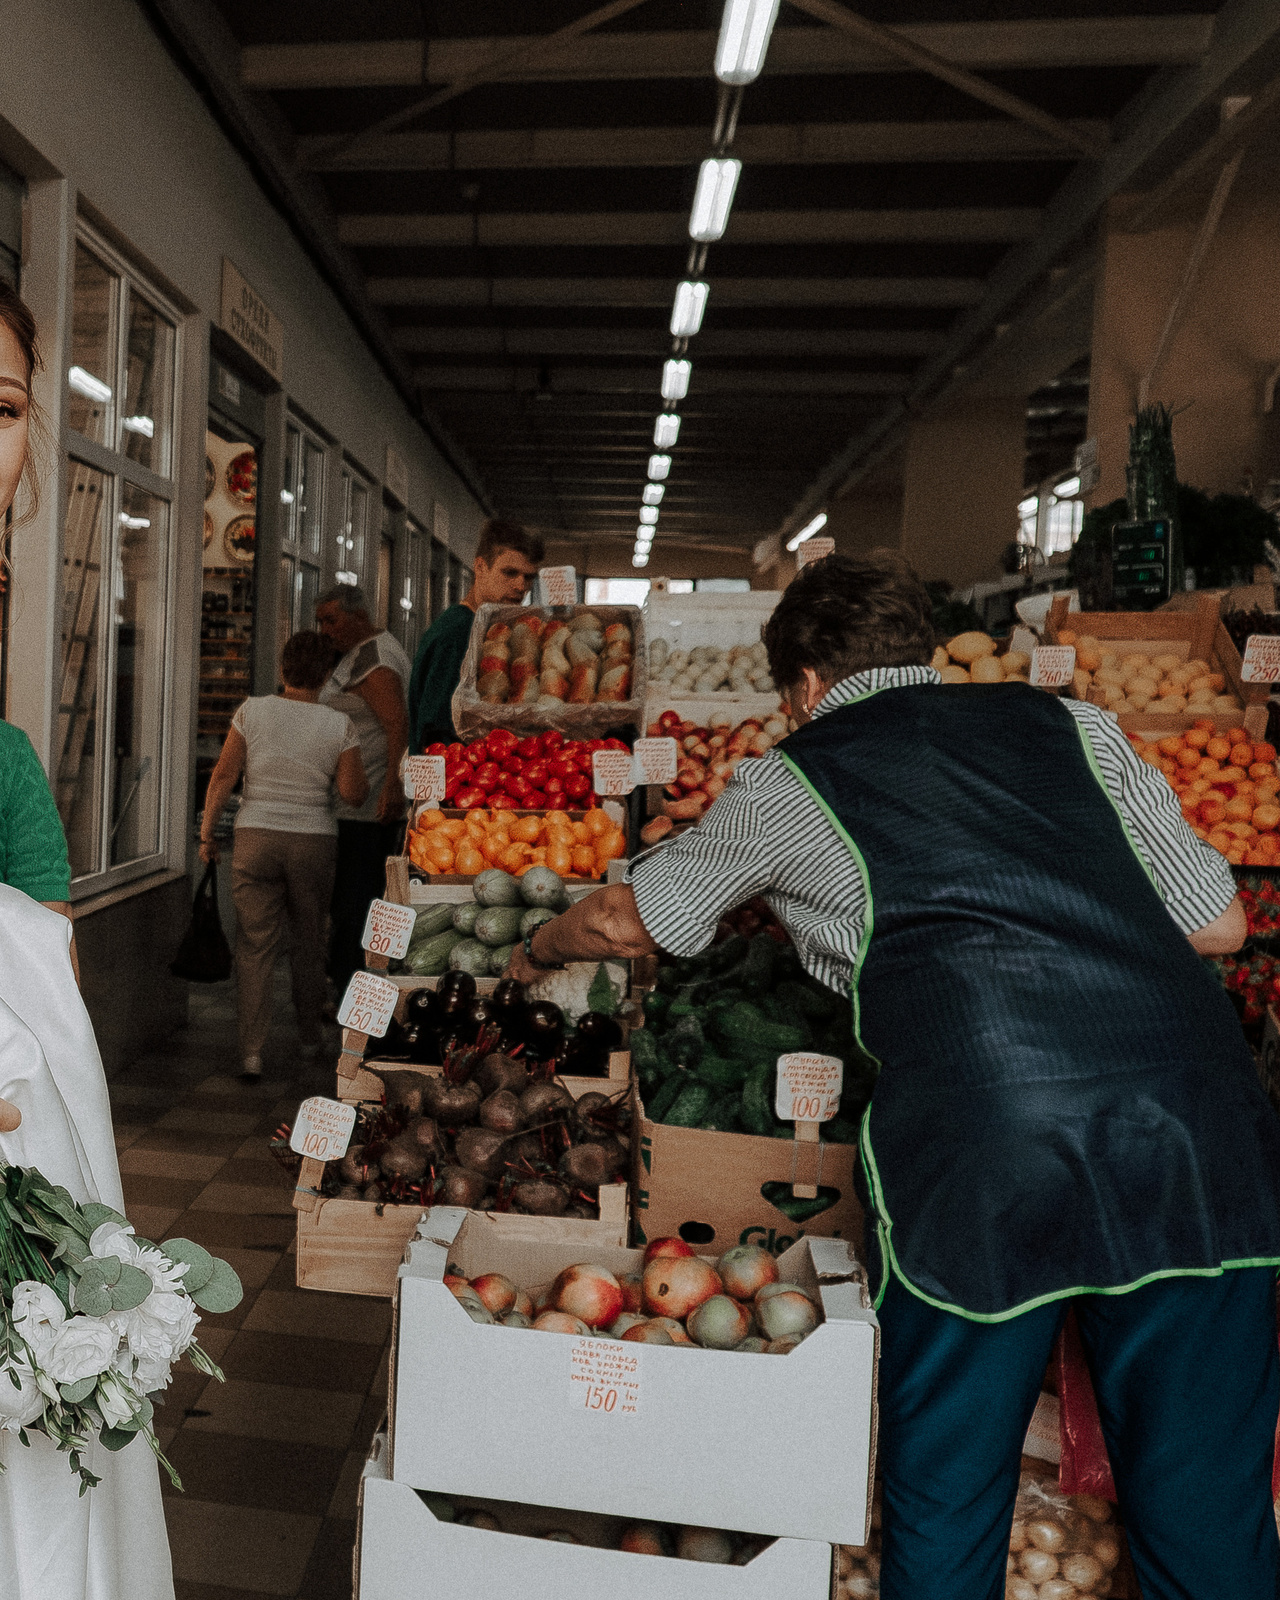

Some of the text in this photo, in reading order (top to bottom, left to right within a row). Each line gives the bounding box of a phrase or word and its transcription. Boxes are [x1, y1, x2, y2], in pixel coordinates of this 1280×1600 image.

[1037, 669, 1062, 684] 260
[1250, 666, 1279, 682] 250
[414, 784, 433, 800] 120
[605, 779, 623, 794] 150
[369, 933, 391, 954] 80
[345, 1006, 373, 1030] 150
[791, 1096, 821, 1119] 100
[301, 1132, 329, 1157] 100
[579, 1339, 623, 1352] ЯБЛОКИ
[585, 1385, 618, 1413] 150
